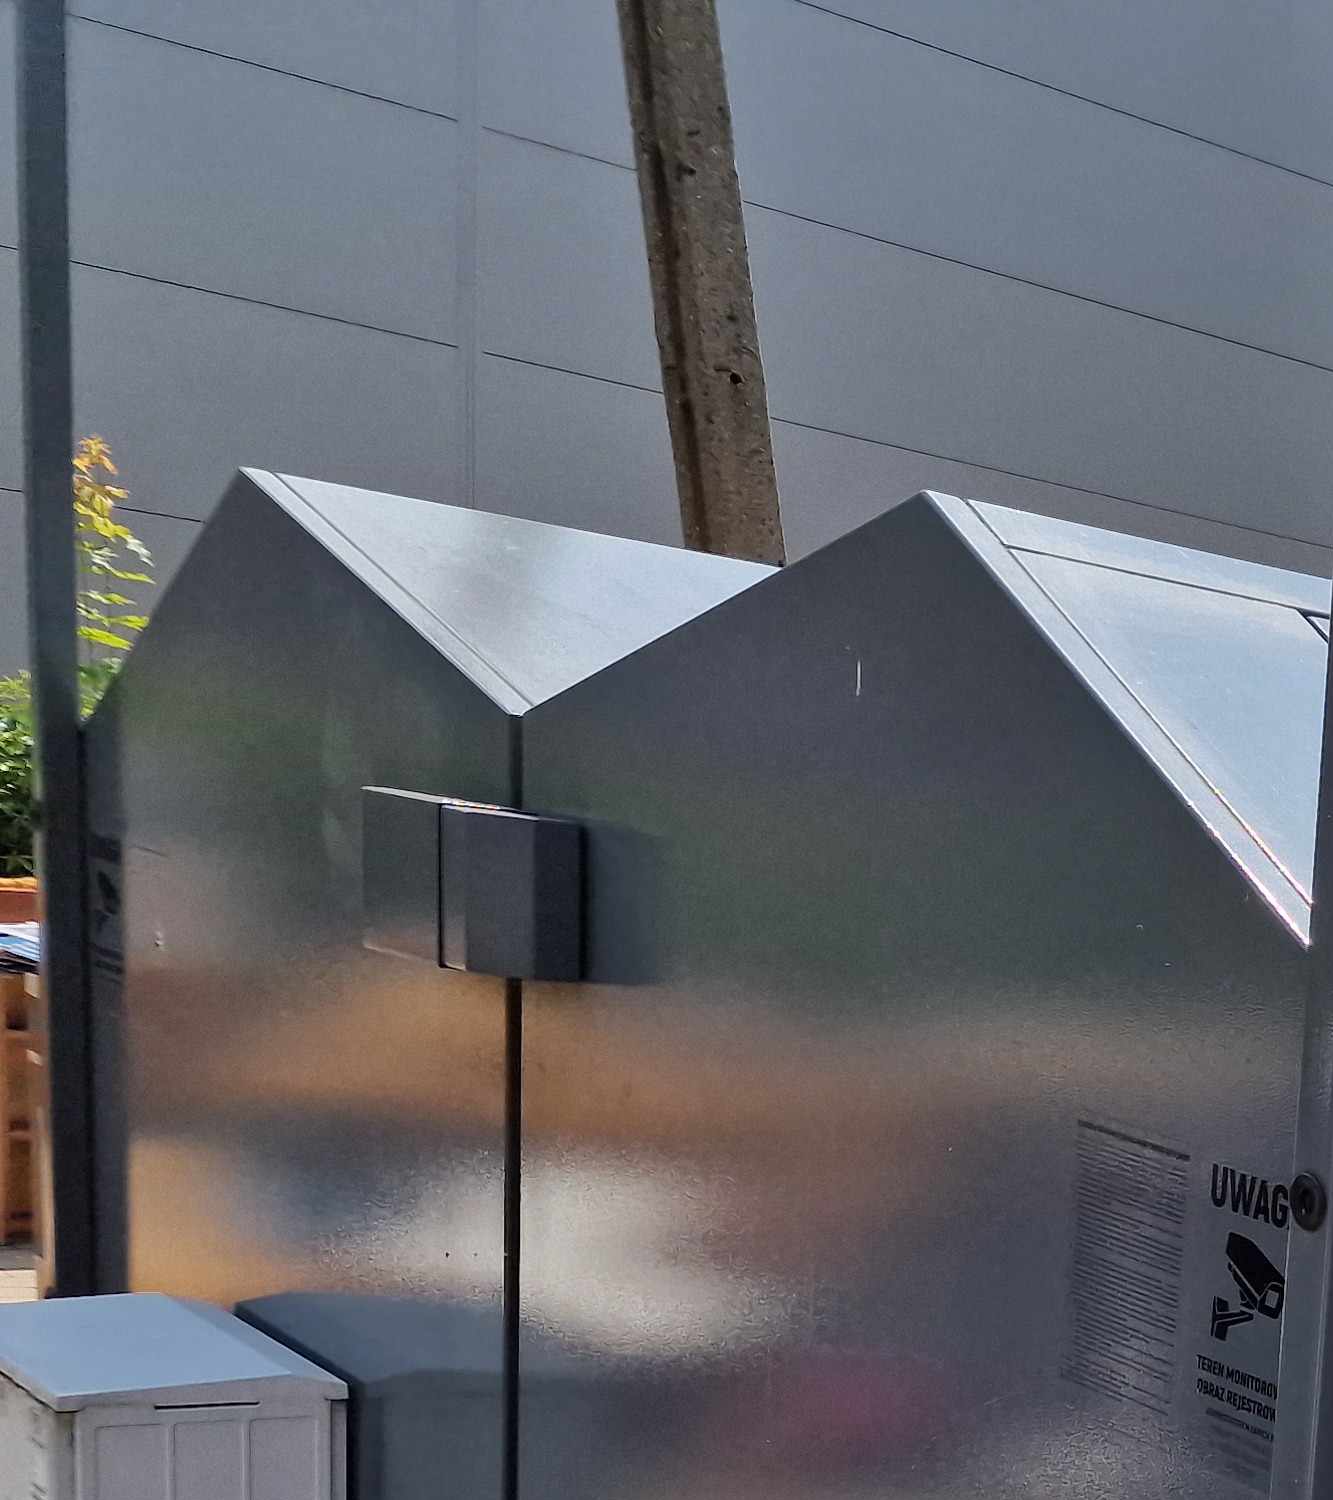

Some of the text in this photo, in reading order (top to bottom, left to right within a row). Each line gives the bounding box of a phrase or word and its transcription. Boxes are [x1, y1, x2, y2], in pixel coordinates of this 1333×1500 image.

[1210, 1163, 1290, 1231] UWAG
[1196, 1353, 1225, 1378] TEREN
[1196, 1377, 1226, 1402] OBRAZ
